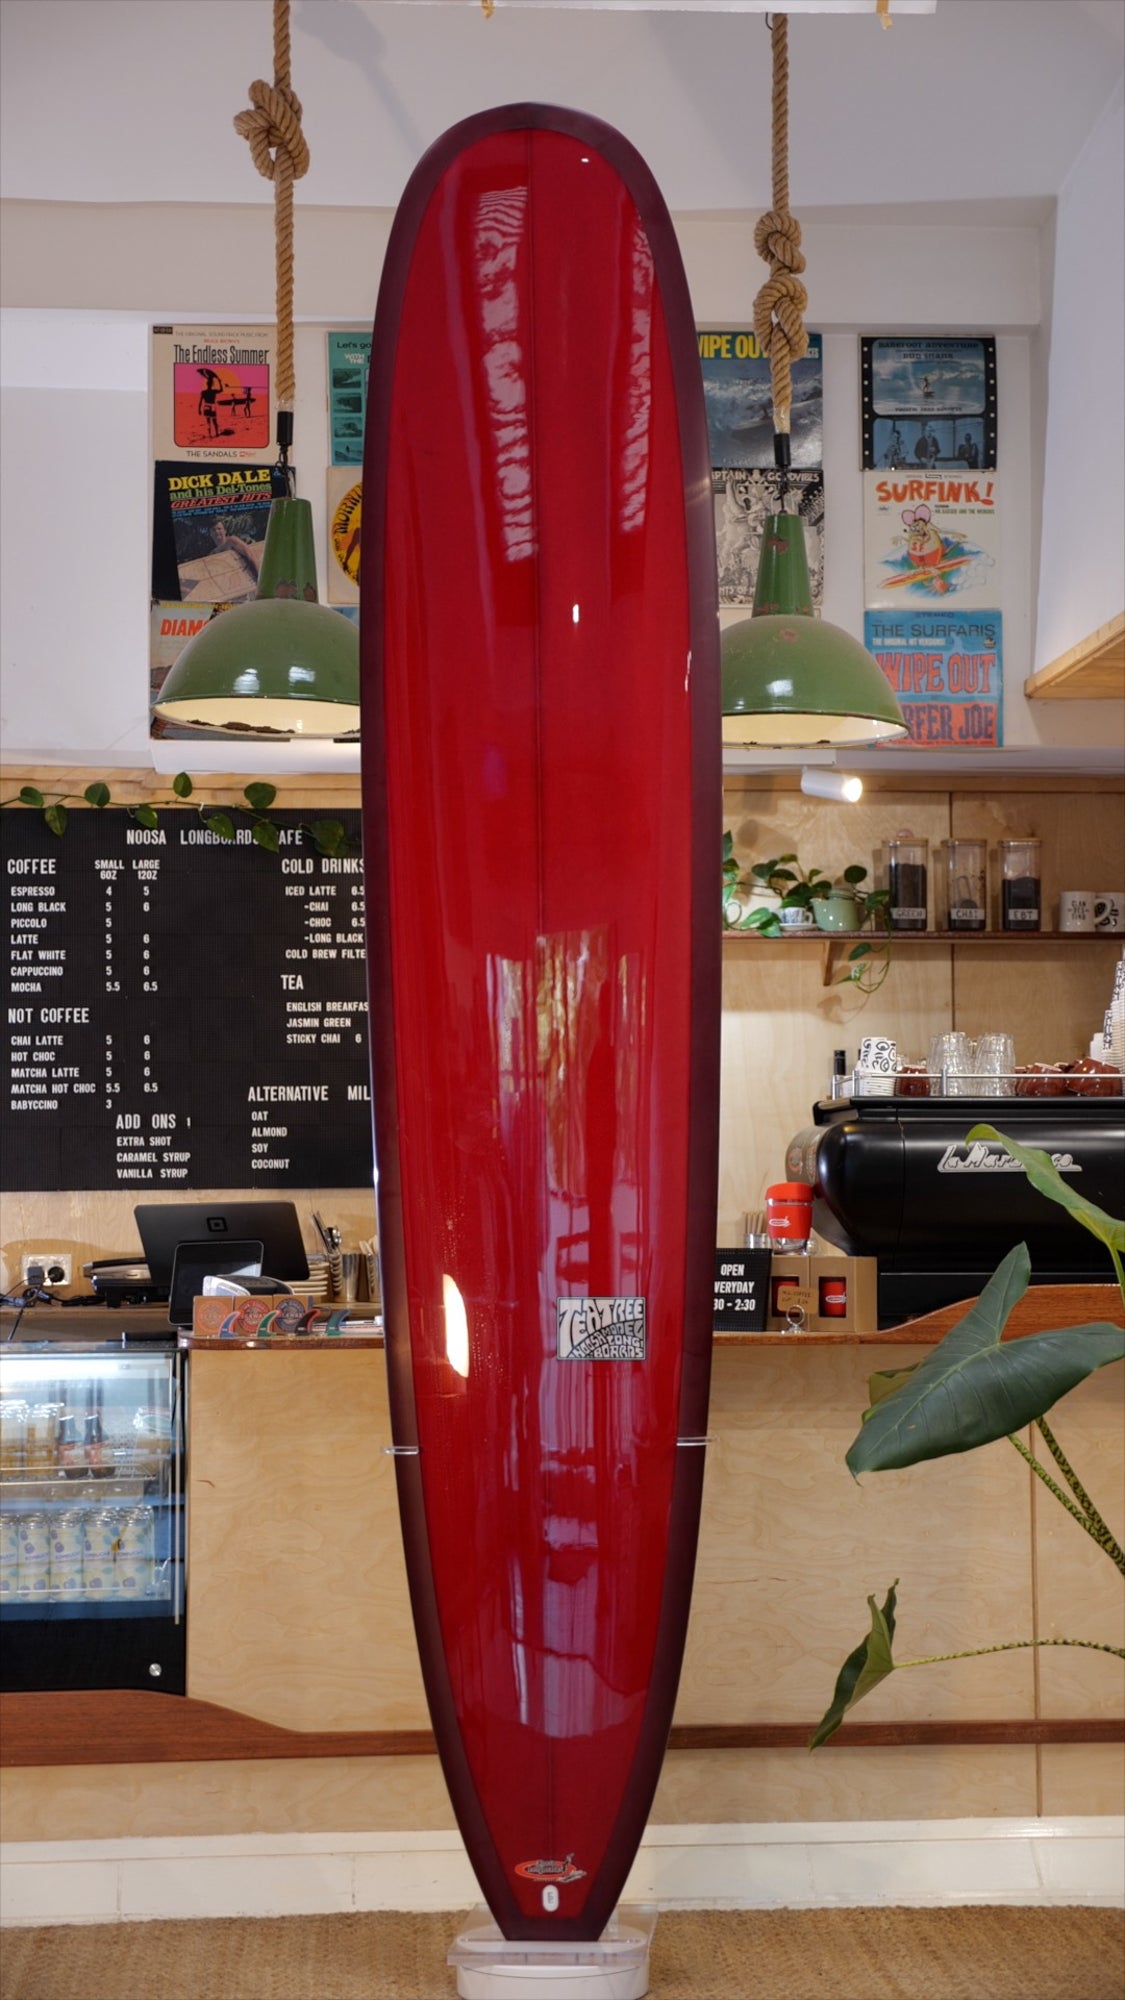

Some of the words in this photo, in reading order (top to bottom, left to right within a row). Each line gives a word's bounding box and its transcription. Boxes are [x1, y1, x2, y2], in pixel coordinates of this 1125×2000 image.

[174, 344, 190, 363] The
[192, 344, 228, 364] Endless
[230, 345, 270, 364] Summer
[168, 474, 213, 490] DICK
[218, 469, 271, 486] DALE
[170, 489, 192, 501] and
[196, 486, 214, 497] his
[170, 494, 238, 509] GREATEST
[241, 492, 272, 501] HITS
[160, 618, 206, 636] DIAM
[872, 624, 904, 637] THE
[911, 624, 996, 637] SURFARIS
[948, 652, 996, 694] OUT
[901, 704, 954, 741] RFER
[958, 704, 993, 740] JOE
[127, 830, 166, 844] NOOSA
[181, 830, 258, 844] LONGBRD
[279, 830, 302, 844] AFE
[8, 859, 56, 874] COFFEE
[95, 860, 124, 870] SMALL
[133, 860, 159, 870] LARGE
[282, 859, 313, 873] COLD
[11, 886, 55, 896] ESPRESSO
[106, 887, 112, 895] 4
[144, 886, 149, 895] 5
[286, 886, 304, 896] ICED
[309, 886, 336, 896] LATTE
[11, 902, 33, 912] LONG
[38, 902, 66, 912] BLACK
[106, 902, 111, 911] 5
[143, 902, 149, 911] 6
[11, 918, 47, 928] PICCOLO
[106, 918, 111, 927] 5
[11, 934, 38, 944] LATTE
[106, 934, 112, 943] 5
[143, 934, 149, 943] 6
[336, 933, 363, 943] BLACK
[11, 950, 33, 960] FLAT
[38, 950, 65, 960] WHITE
[106, 950, 112, 959] 5
[144, 950, 149, 959] 6
[286, 949, 307, 959] COLD
[312, 949, 337, 959] BREW
[342, 949, 366, 959] FILTE
[11, 966, 63, 976] CAPPUCCINO
[106, 966, 112, 975] 5
[144, 966, 149, 975] 6
[11, 983, 41, 992] MOCHA
[106, 982, 120, 991] 5.5
[144, 982, 157, 991] 6.5
[281, 975, 303, 990] TEA
[287, 1002, 321, 1012] ENGLISH
[326, 1002, 369, 1011] BREAKFAS
[8, 1008, 33, 1023] NOT
[41, 1008, 89, 1023] COFFEE
[287, 1018, 319, 1027] JASMIN
[324, 1018, 351, 1027] GREEN
[11, 1036, 31, 1045] CHAI
[36, 1036, 63, 1045] LATTE
[106, 1035, 112, 1045] 5
[144, 1035, 150, 1044] 6
[287, 1034, 316, 1043] STICKY
[321, 1034, 340, 1043] CHAI
[355, 1034, 361, 1043] 6
[11, 1052, 28, 1061] HOT
[33, 1052, 55, 1061] CHOC
[106, 1051, 112, 1060] 5
[144, 1051, 150, 1060] 6
[11, 1068, 47, 1078] MATCHA
[52, 1067, 79, 1077] LATTE
[106, 1067, 112, 1076] 5
[144, 1067, 150, 1076] 6
[11, 1084, 47, 1094] MATCHA
[52, 1084, 68, 1093] HOT
[74, 1083, 95, 1093] CHOC
[106, 1083, 120, 1093] 5.5
[144, 1083, 158, 1092] 6.5
[248, 1086, 328, 1101] ALTERNATIVE
[348, 1085, 372, 1100] MIL
[11, 1100, 58, 1110] BABYCCINO
[106, 1099, 112, 1109] 3
[252, 1111, 268, 1120] OAT
[116, 1114, 140, 1129] ADD
[152, 1114, 176, 1129] ONS
[252, 1127, 287, 1137] ALMOND
[117, 1137, 144, 1146] EXTRA
[150, 1136, 171, 1146] SHOT
[252, 1143, 268, 1153] SOY
[117, 1152, 157, 1162] CARAMEL
[163, 1152, 190, 1162] SYRUP
[252, 1159, 289, 1169] COCONUT
[117, 1169, 152, 1178] VANILLA
[160, 1168, 188, 1178] SYRUP
[720, 1264, 744, 1276] OPEN
[714, 1281, 755, 1293] VERYDAY
[713, 1299, 724, 1310] 30
[735, 1299, 755, 1311] 2:30
